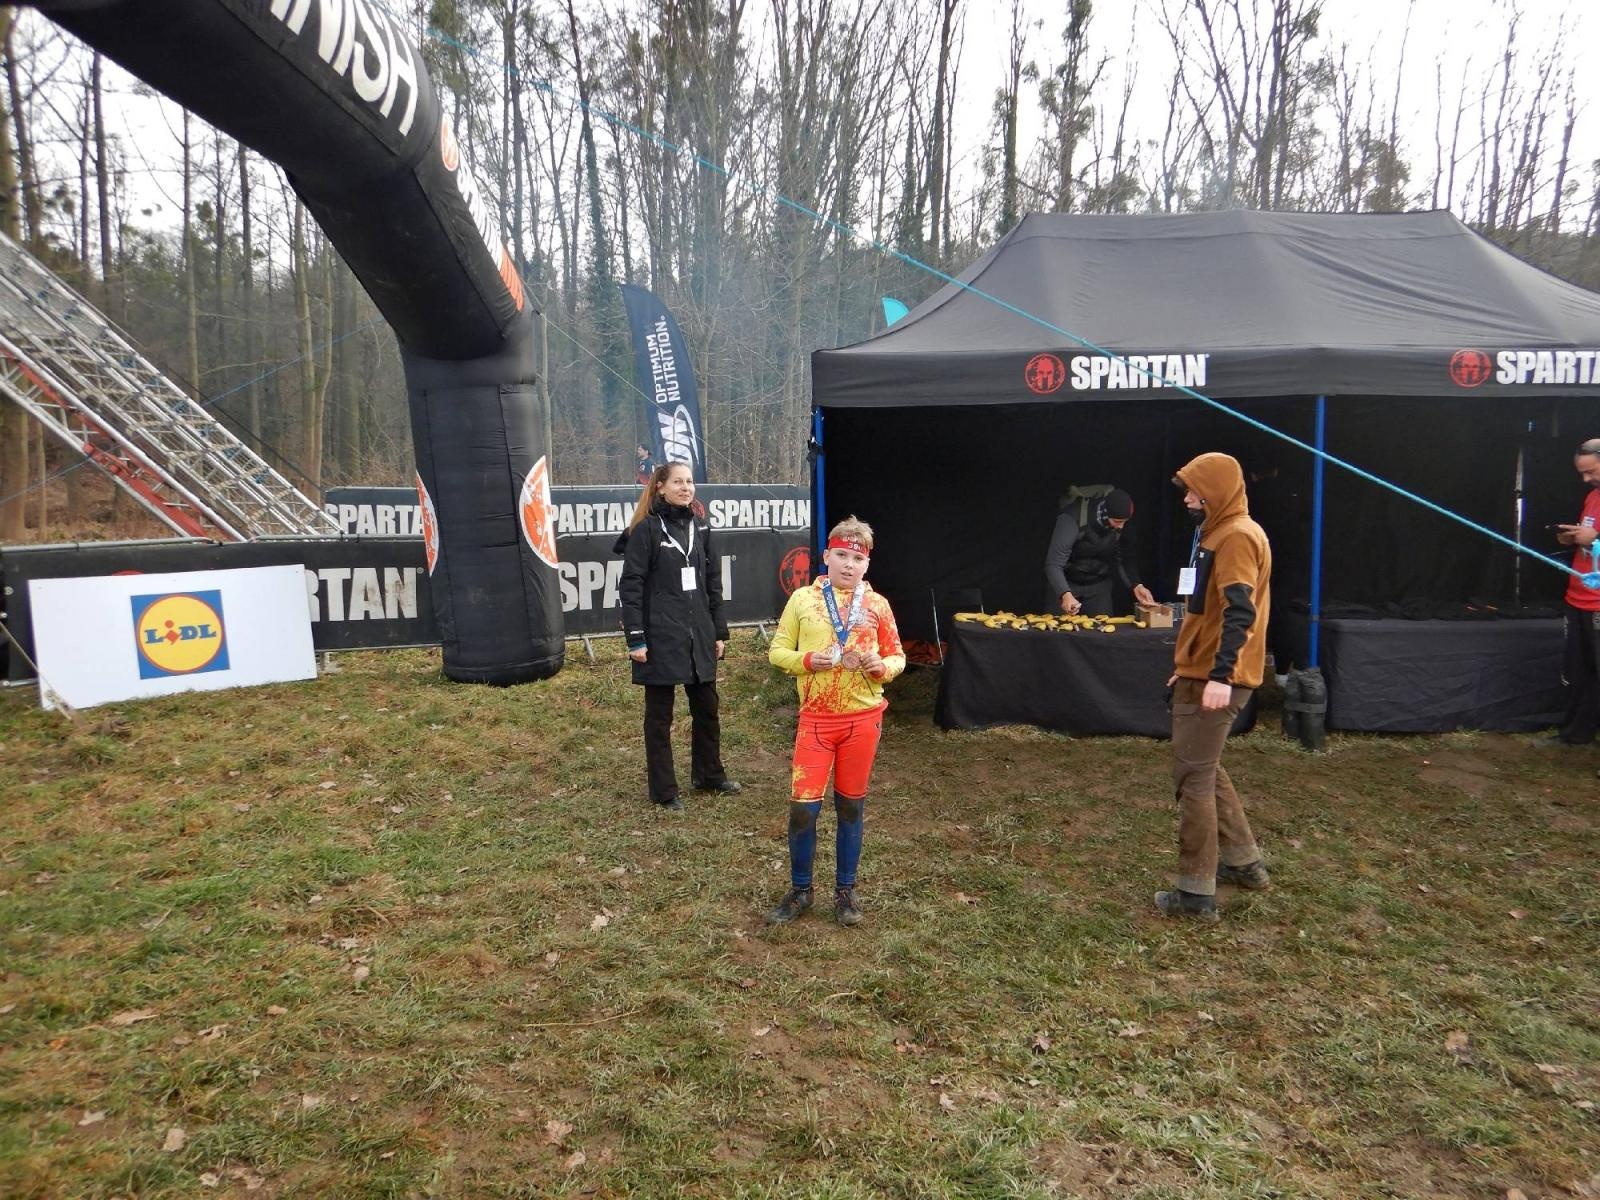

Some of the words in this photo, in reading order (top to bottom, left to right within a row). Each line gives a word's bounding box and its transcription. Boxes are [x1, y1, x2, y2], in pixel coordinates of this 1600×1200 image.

[645, 333, 667, 404] OPTIMUM
[655, 319, 681, 402] NUTRITION
[1070, 353, 1208, 390] SPARTAN
[709, 499, 811, 528] SPARTAN
